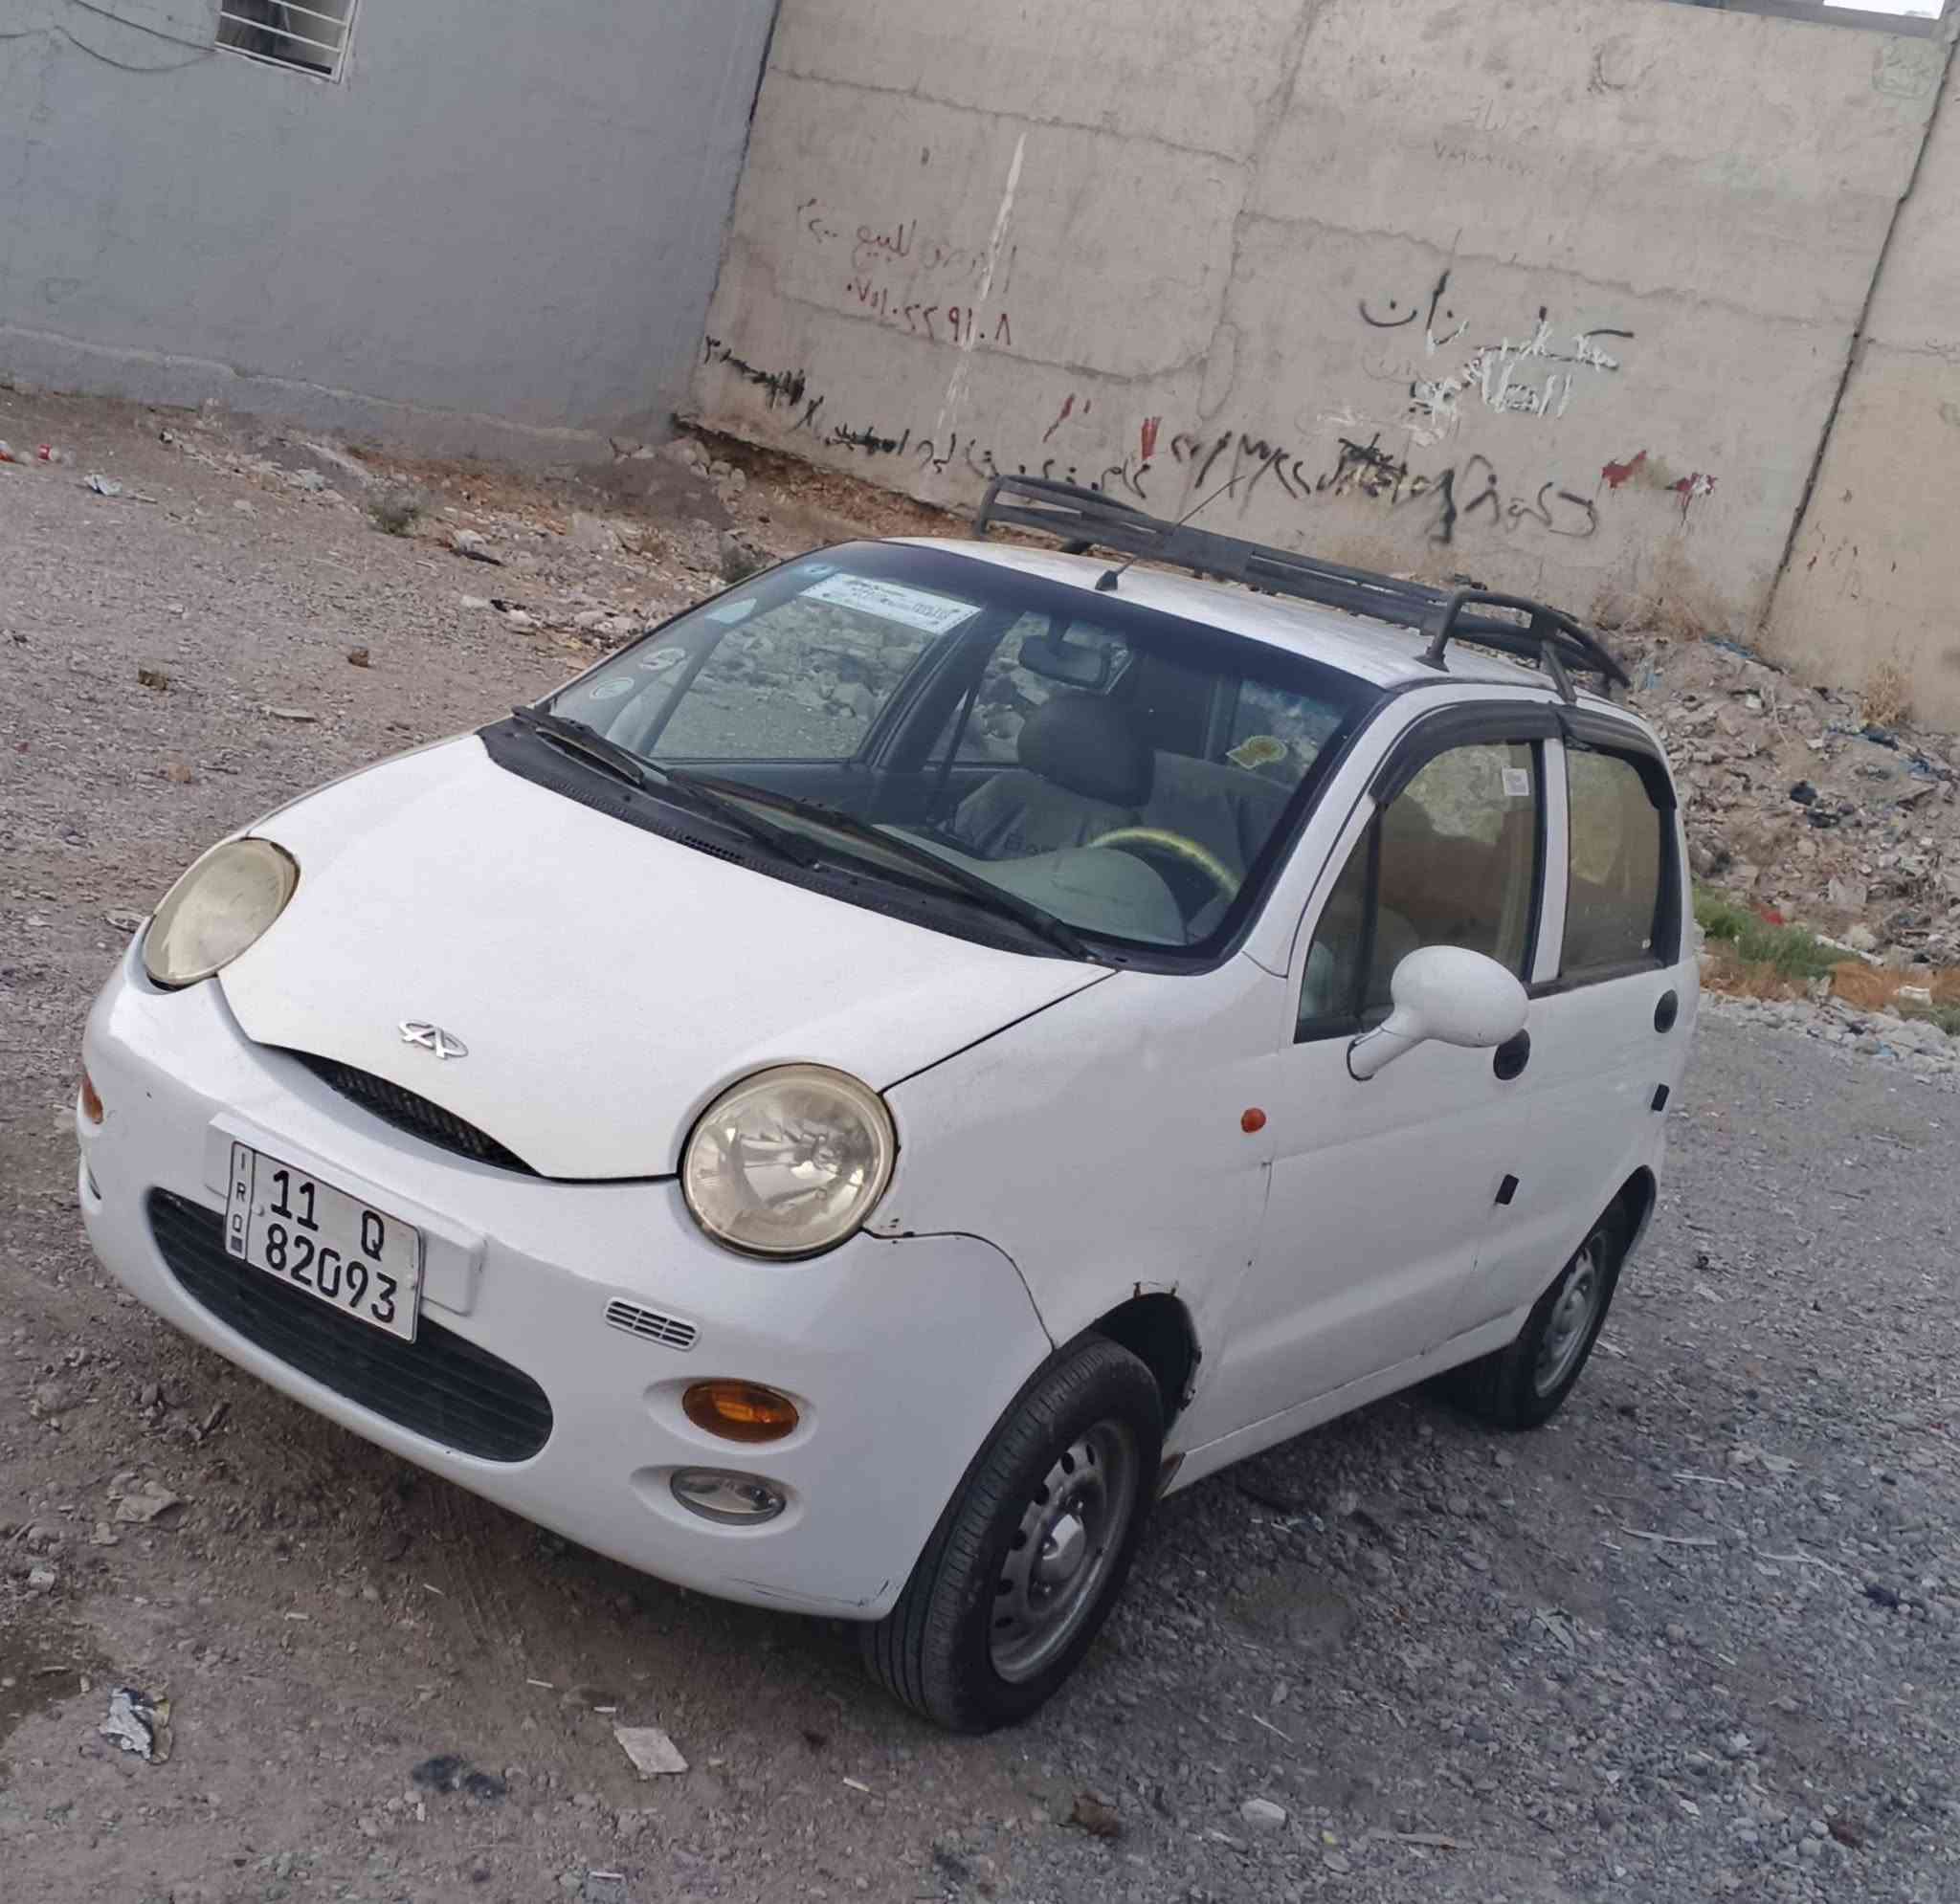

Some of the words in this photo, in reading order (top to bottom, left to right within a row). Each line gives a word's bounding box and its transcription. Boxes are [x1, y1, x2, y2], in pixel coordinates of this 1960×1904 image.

[270, 1169, 320, 1232] 11
[360, 1209, 385, 1261] Q
[265, 1223, 397, 1324] 82093
